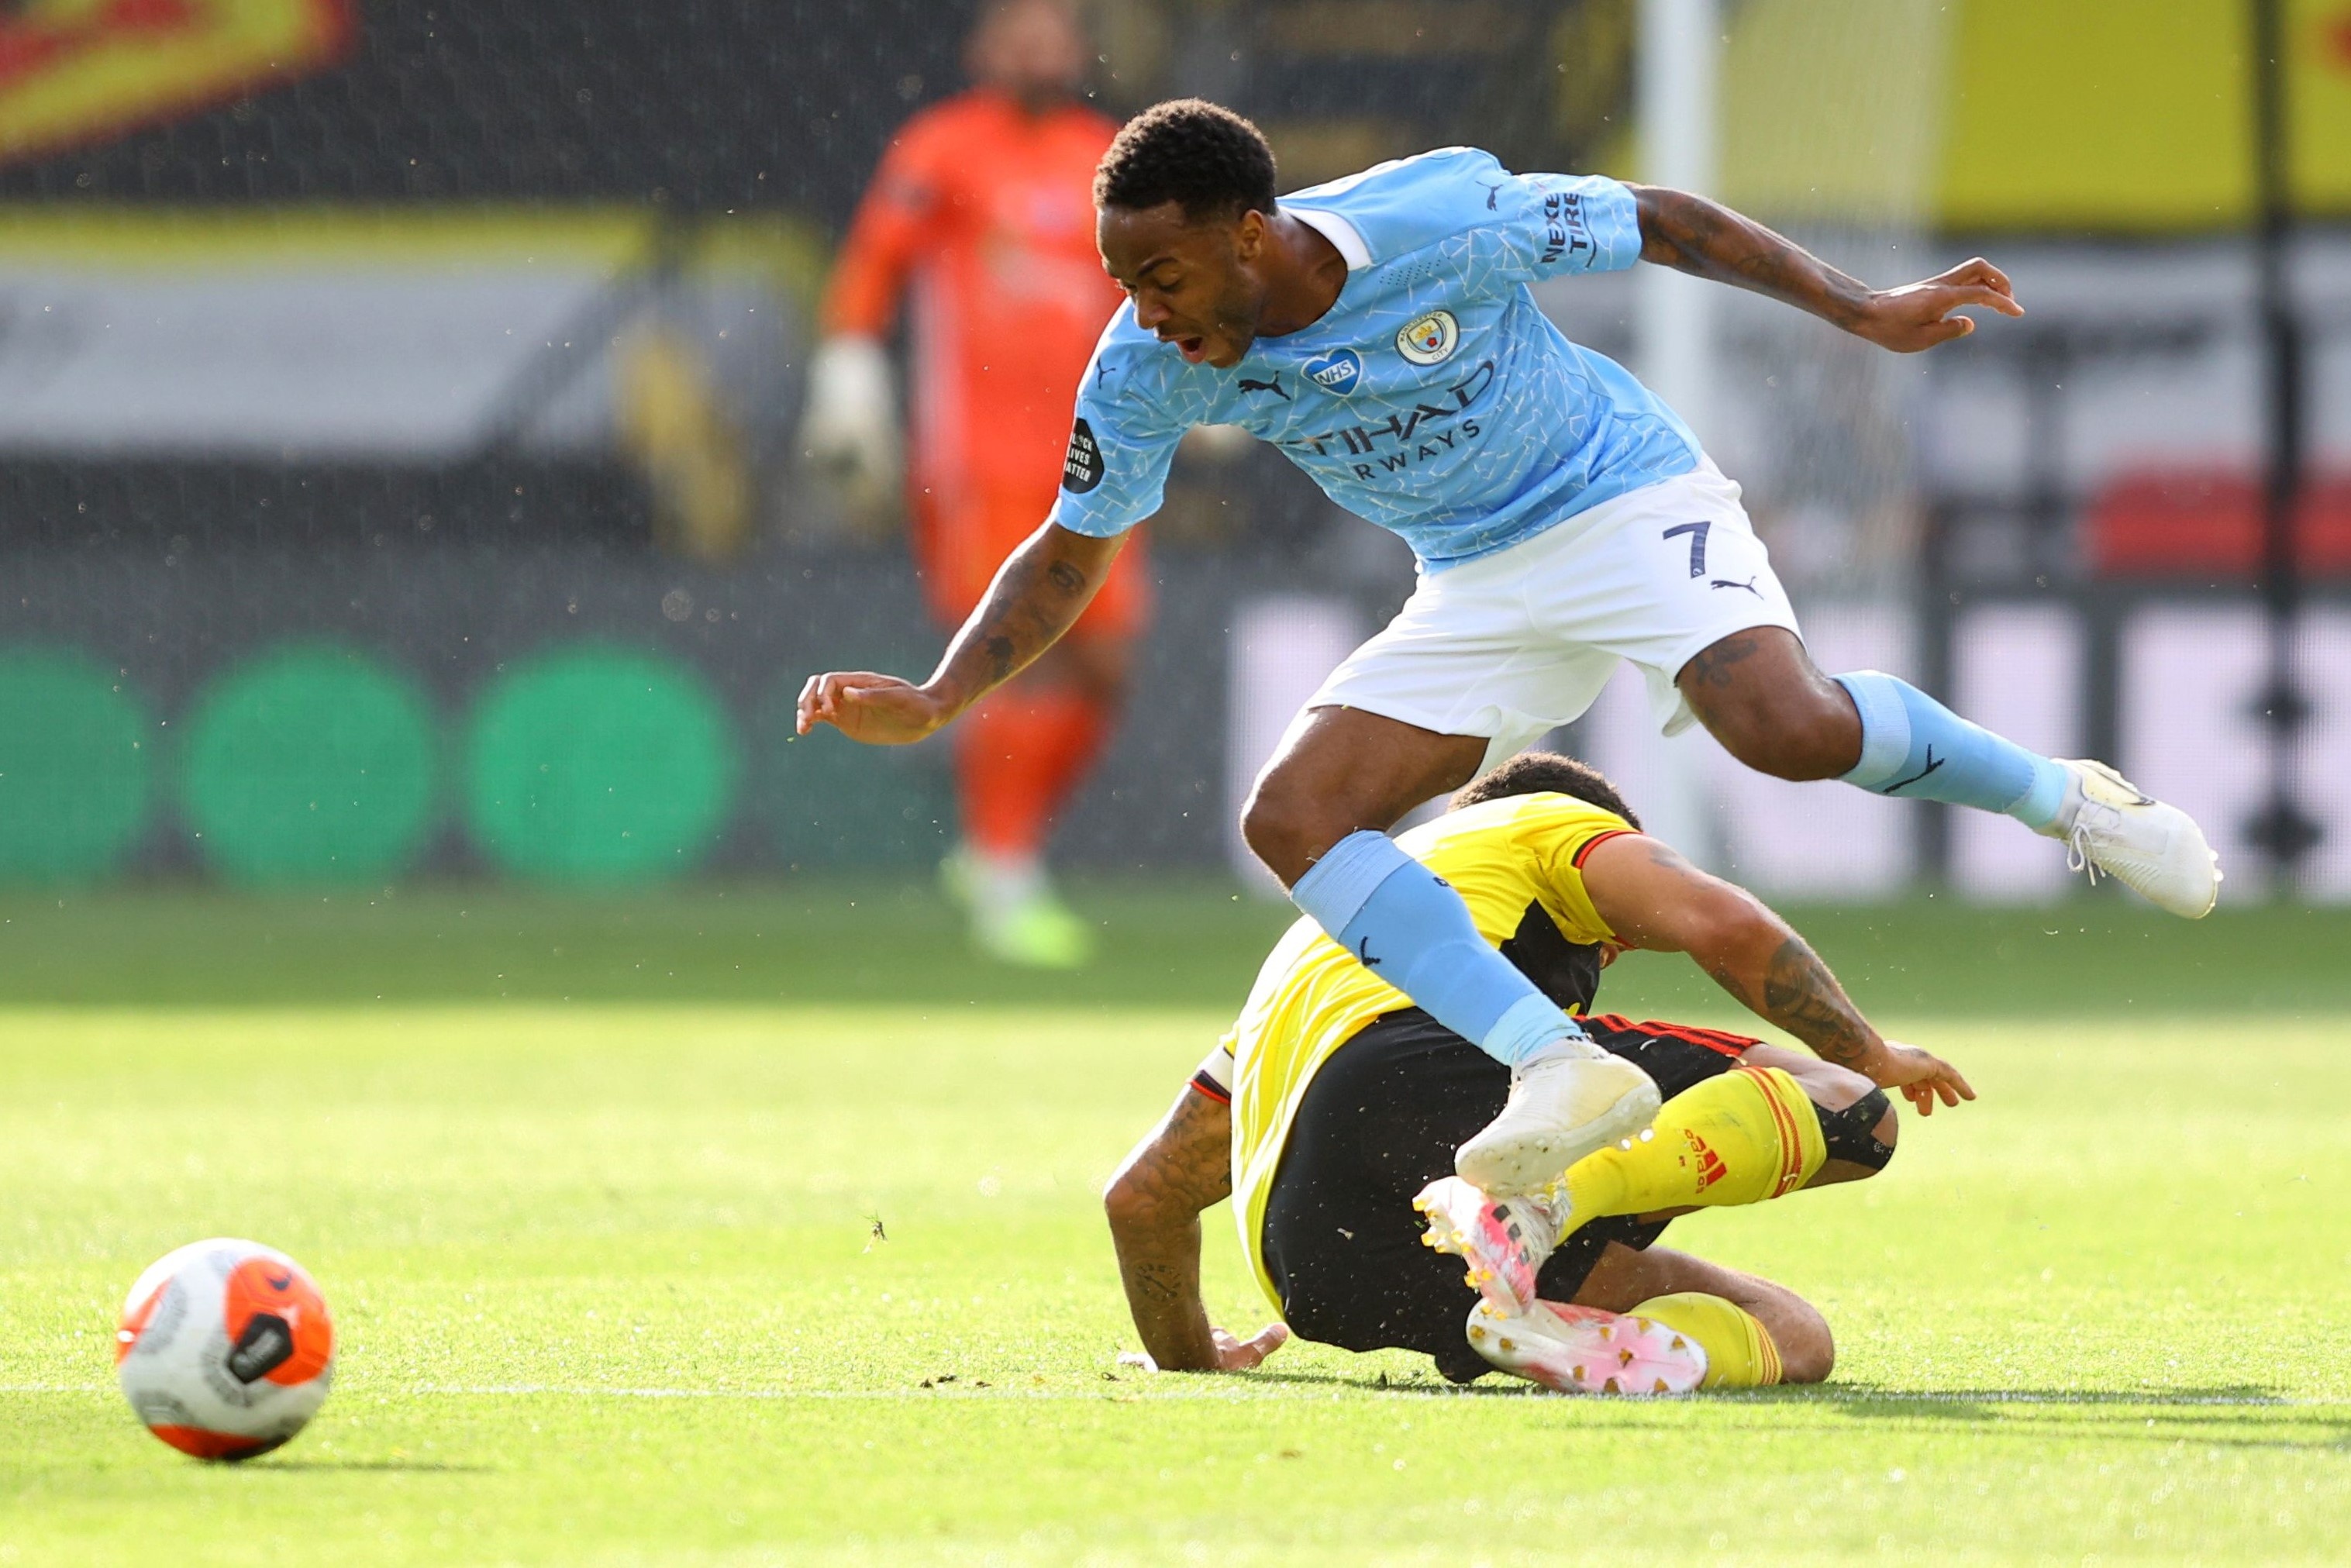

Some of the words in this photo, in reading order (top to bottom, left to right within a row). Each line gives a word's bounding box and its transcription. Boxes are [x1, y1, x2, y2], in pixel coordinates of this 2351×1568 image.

[1564, 192, 1587, 254] TIRE
[1318, 361, 1353, 384] NHS
[1432, 346, 1449, 360] CITY
[1277, 360, 1494, 456] TIHAD
[1065, 461, 1091, 482] ATTER
[1663, 521, 1712, 579] 7
[1684, 1129, 1706, 1194] adidas
